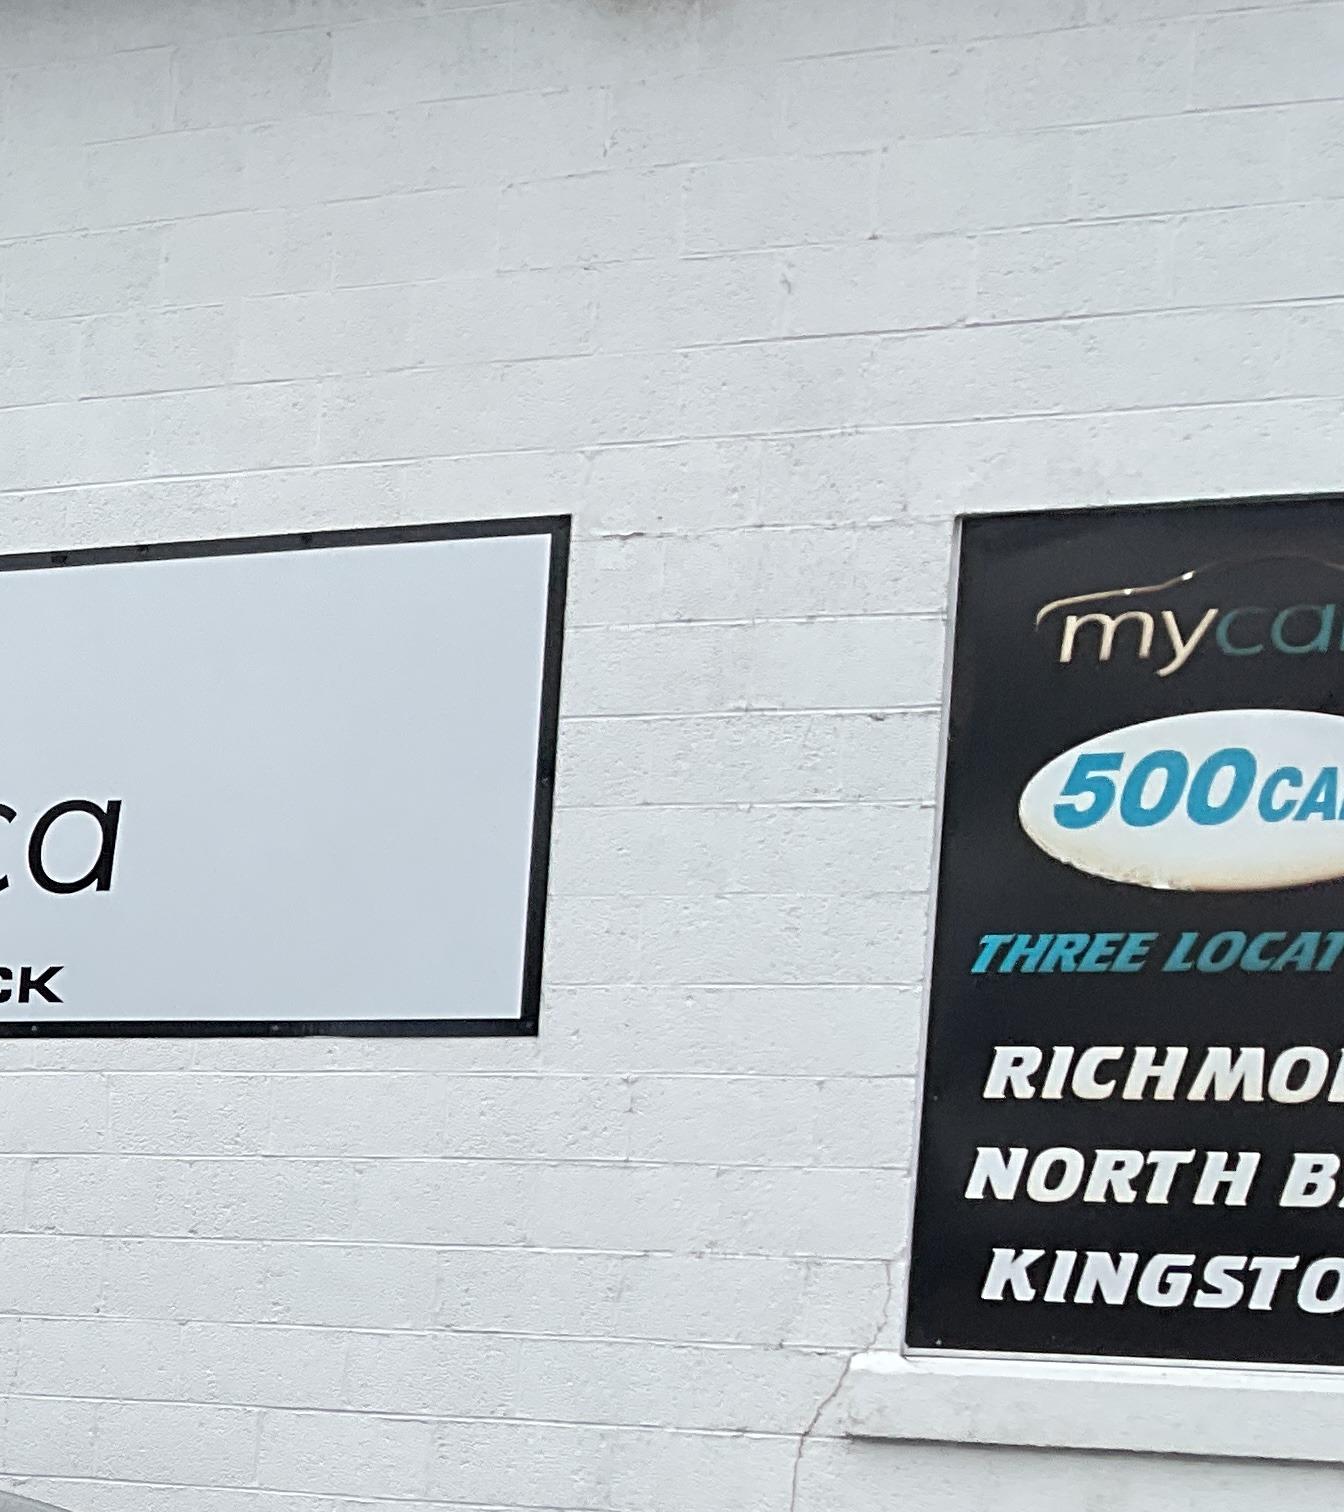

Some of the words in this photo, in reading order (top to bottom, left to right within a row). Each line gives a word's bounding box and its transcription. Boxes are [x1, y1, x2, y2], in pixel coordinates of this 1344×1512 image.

[1059, 603, 1344, 678] myca
[1258, 766, 1344, 822] CA
[970, 932, 1159, 973] THREE
[983, 1045, 1344, 1104] RICHMO
[964, 1147, 1261, 1206] NORTH
[1279, 1152, 1344, 1207] B
[981, 1248, 1344, 1313] KINGSTO
